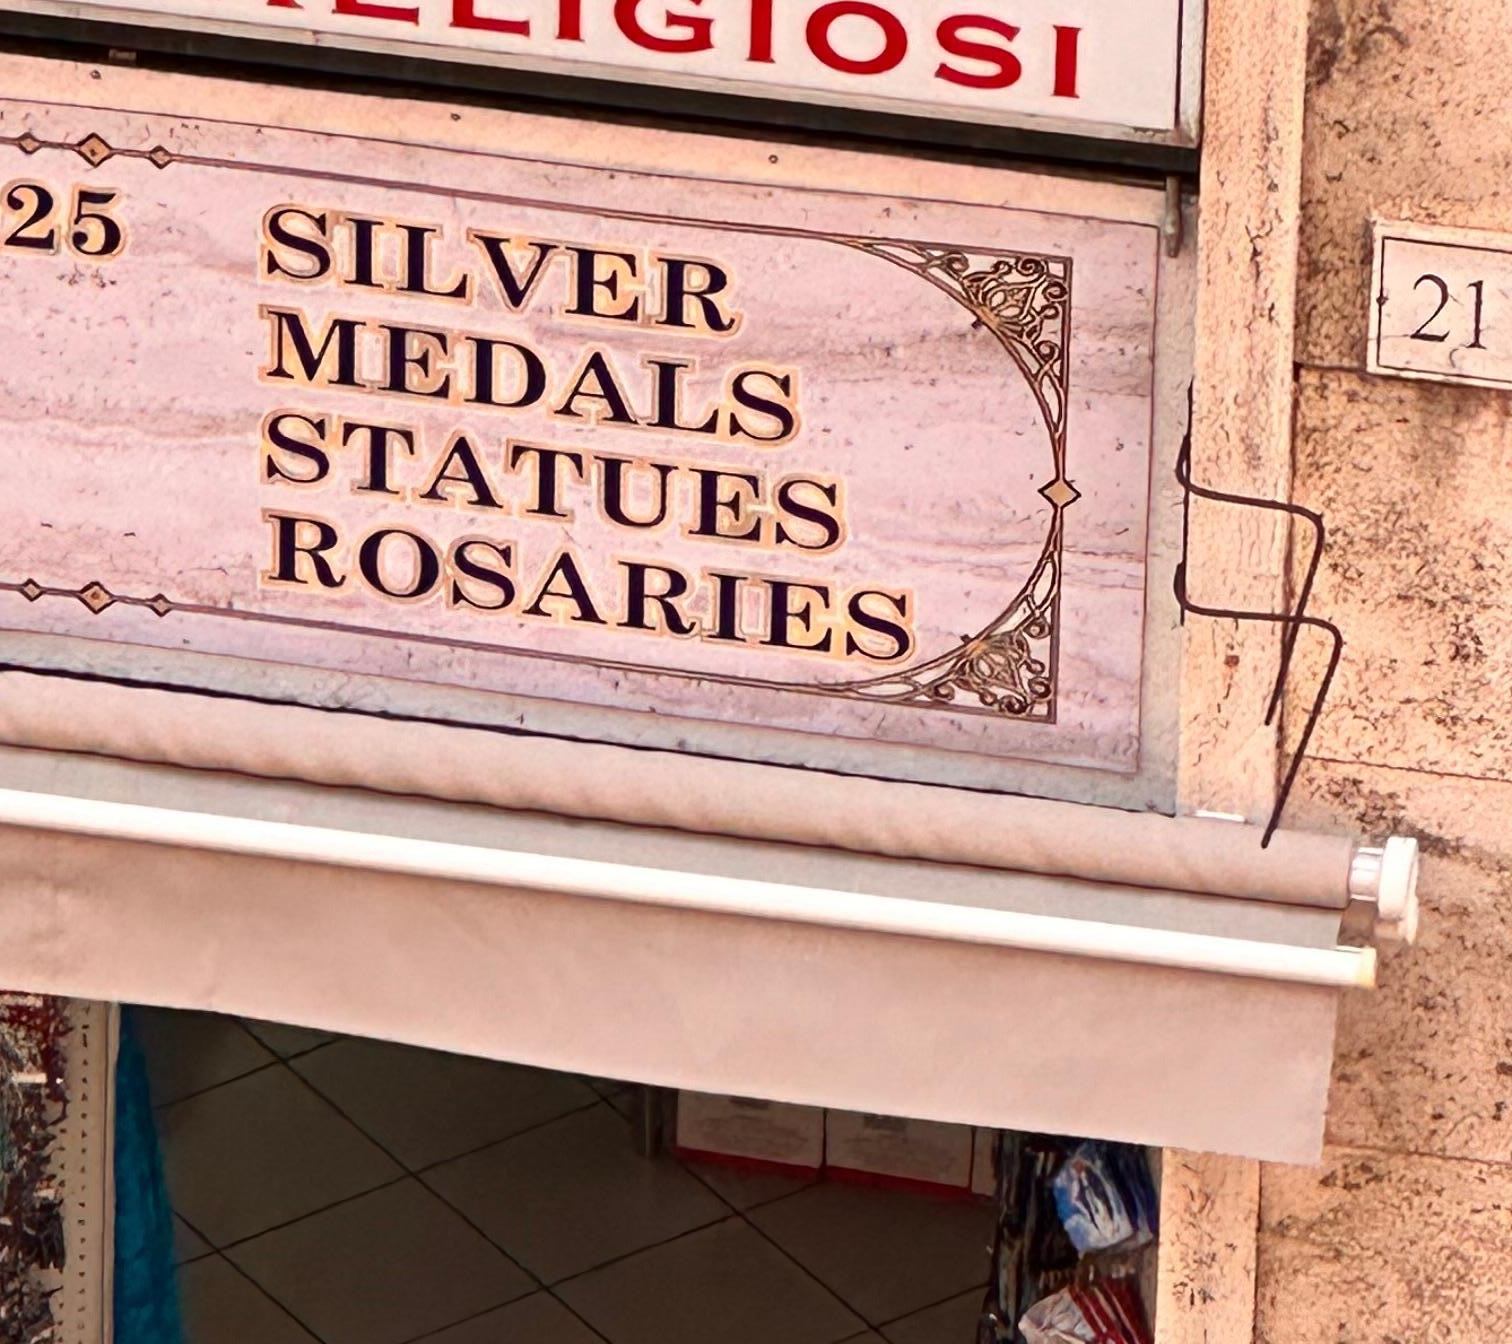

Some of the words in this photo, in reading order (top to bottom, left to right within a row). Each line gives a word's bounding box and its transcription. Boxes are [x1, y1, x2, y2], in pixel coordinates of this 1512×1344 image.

[264, 206, 737, 334] SILVER
[1409, 273, 1487, 350] 21
[260, 306, 799, 443] MEDALS
[264, 412, 844, 551] STATUES
[264, 512, 913, 662] ROSARIES
